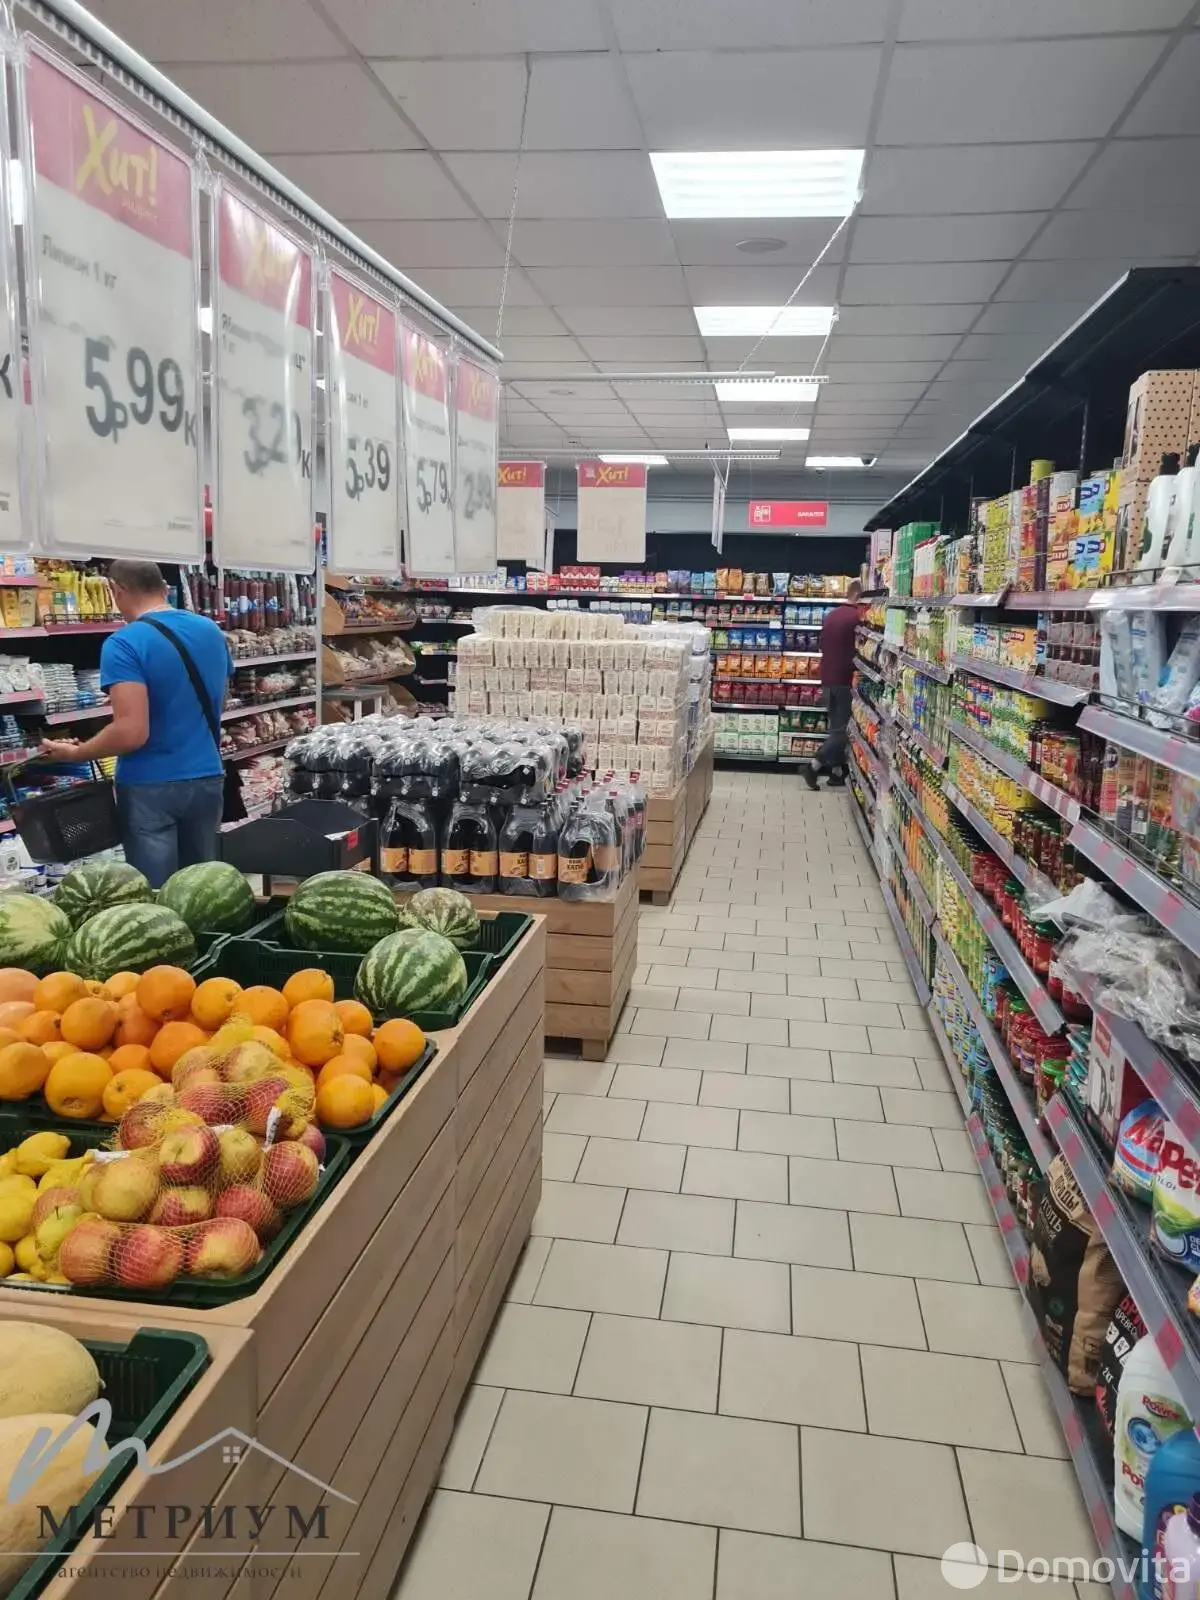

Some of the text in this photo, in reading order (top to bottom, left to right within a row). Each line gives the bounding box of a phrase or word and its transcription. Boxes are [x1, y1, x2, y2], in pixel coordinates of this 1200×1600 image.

[76, 104, 158, 206] Хит!
[343, 293, 381, 346] Хит!
[498, 467, 526, 483] Хит!
[596, 466, 629, 486] Хит!
